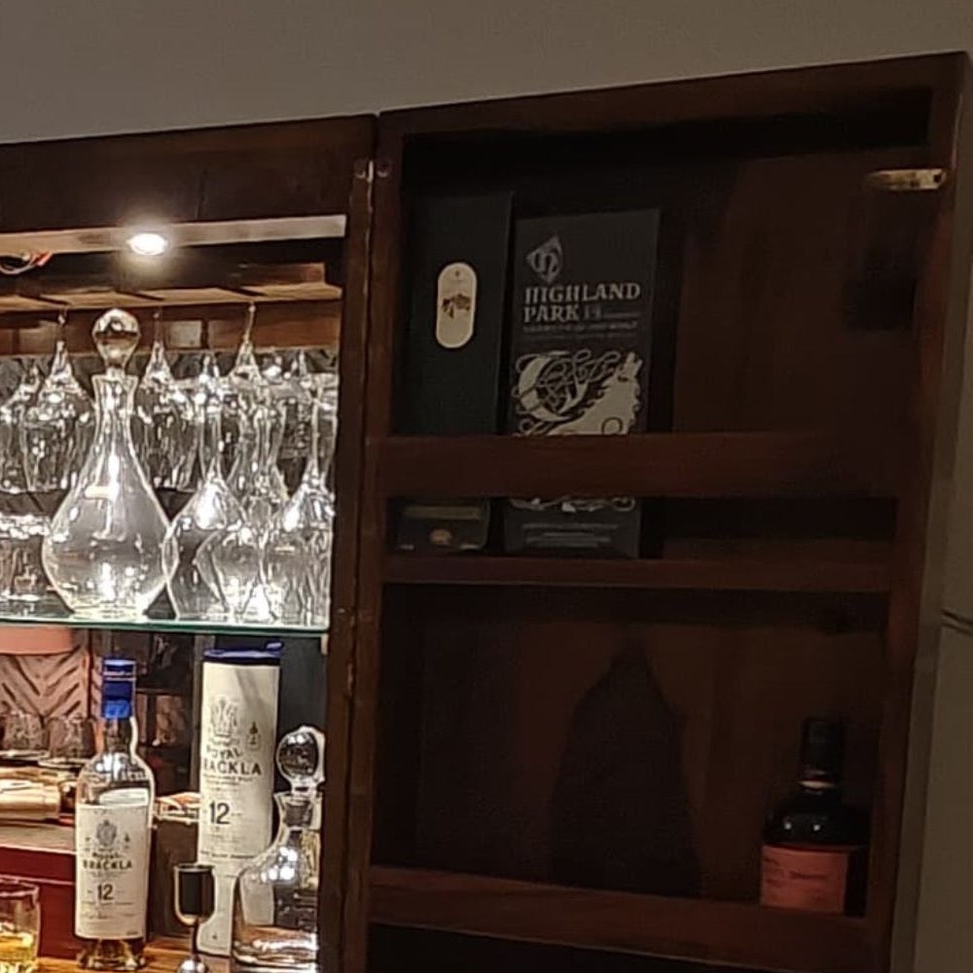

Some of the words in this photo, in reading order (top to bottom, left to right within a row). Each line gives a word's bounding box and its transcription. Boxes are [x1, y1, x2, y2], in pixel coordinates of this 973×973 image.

[524, 282, 641, 305] HIGHLAND
[523, 304, 579, 323] PARK
[209, 801, 230, 825] 12
[97, 883, 114, 901] 12
